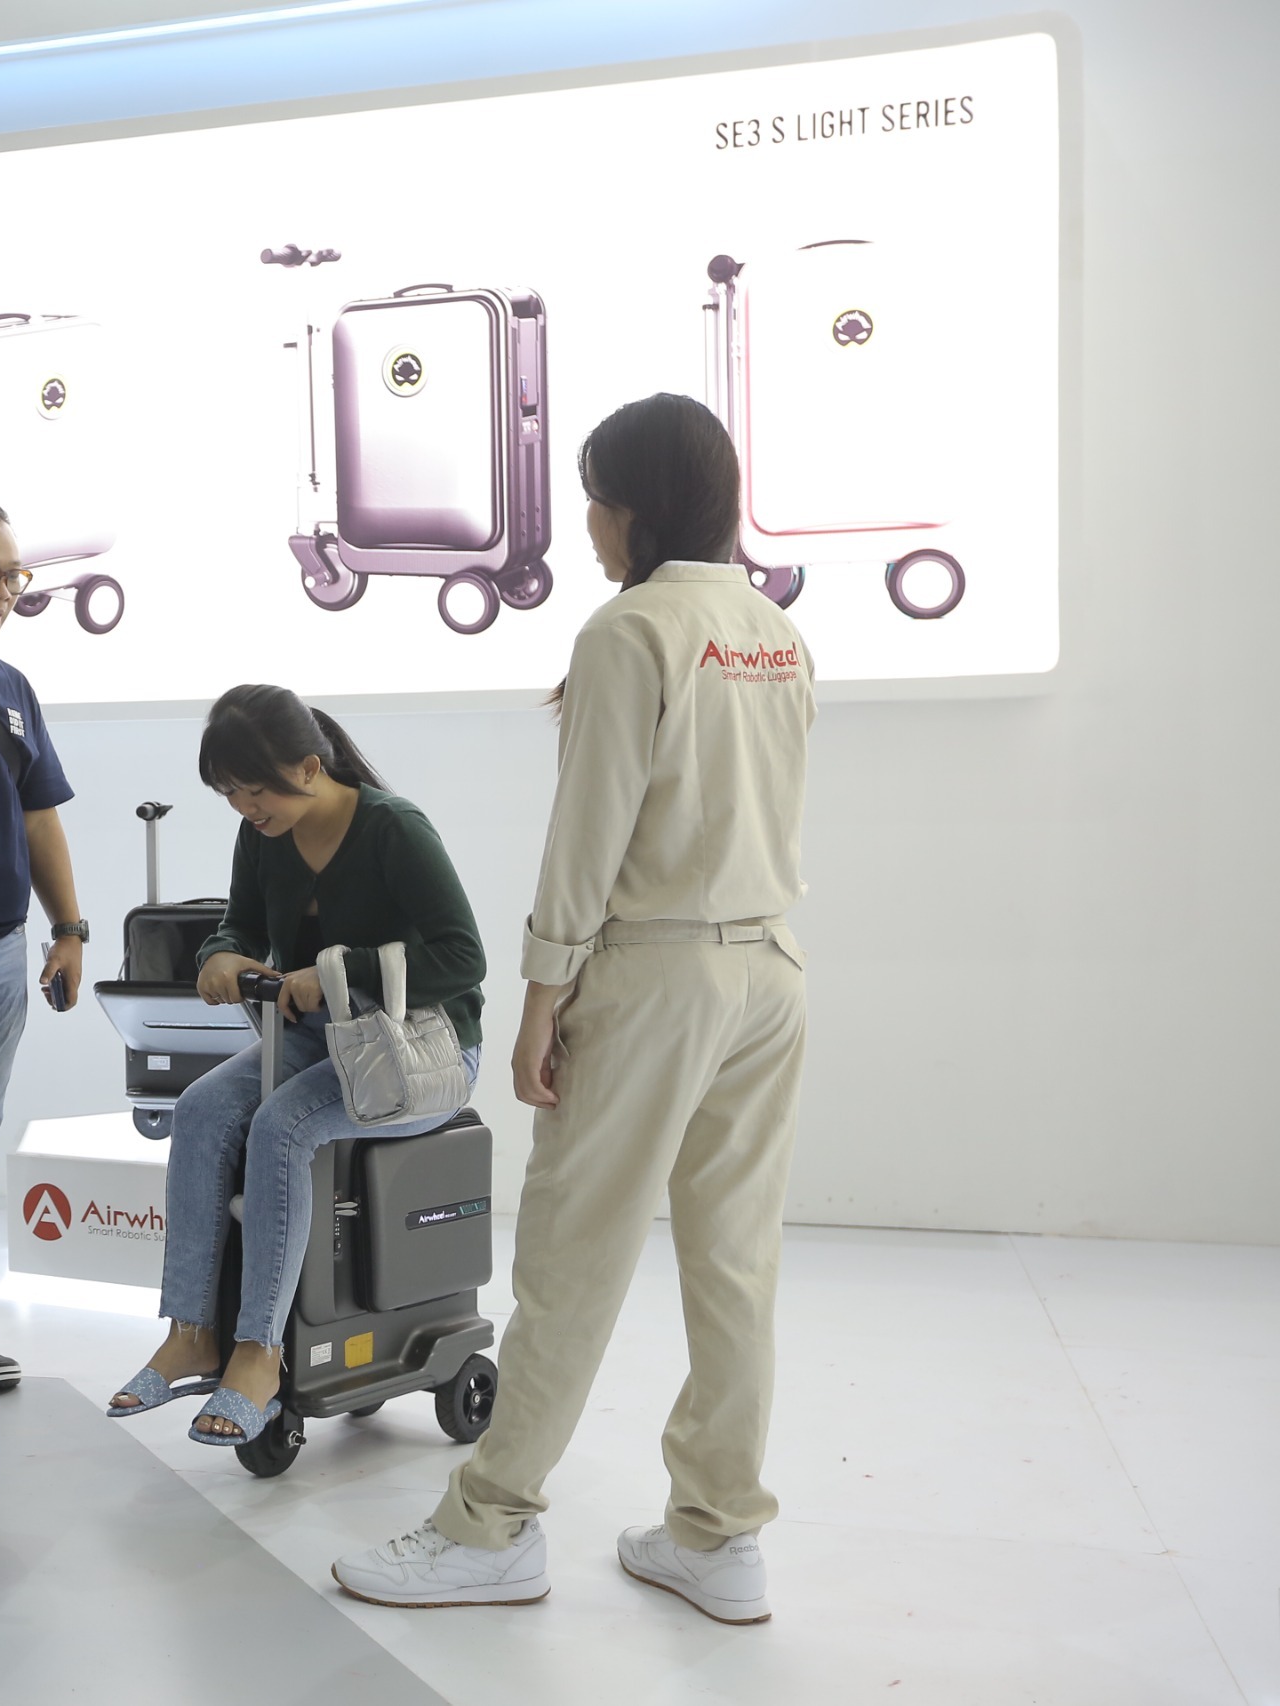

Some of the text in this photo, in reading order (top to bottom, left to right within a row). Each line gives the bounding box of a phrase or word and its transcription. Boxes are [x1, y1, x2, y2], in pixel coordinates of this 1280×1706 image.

[715, 95, 975, 150] SE3 S LIGHT SERIES
[700, 639, 801, 669] Airwheel
[722, 670, 797, 682] Smart Robotic Luggage
[80, 1200, 167, 1231] Airwh
[87, 1225, 113, 1236] Smart
[116, 1229, 152, 1241] Robotic
